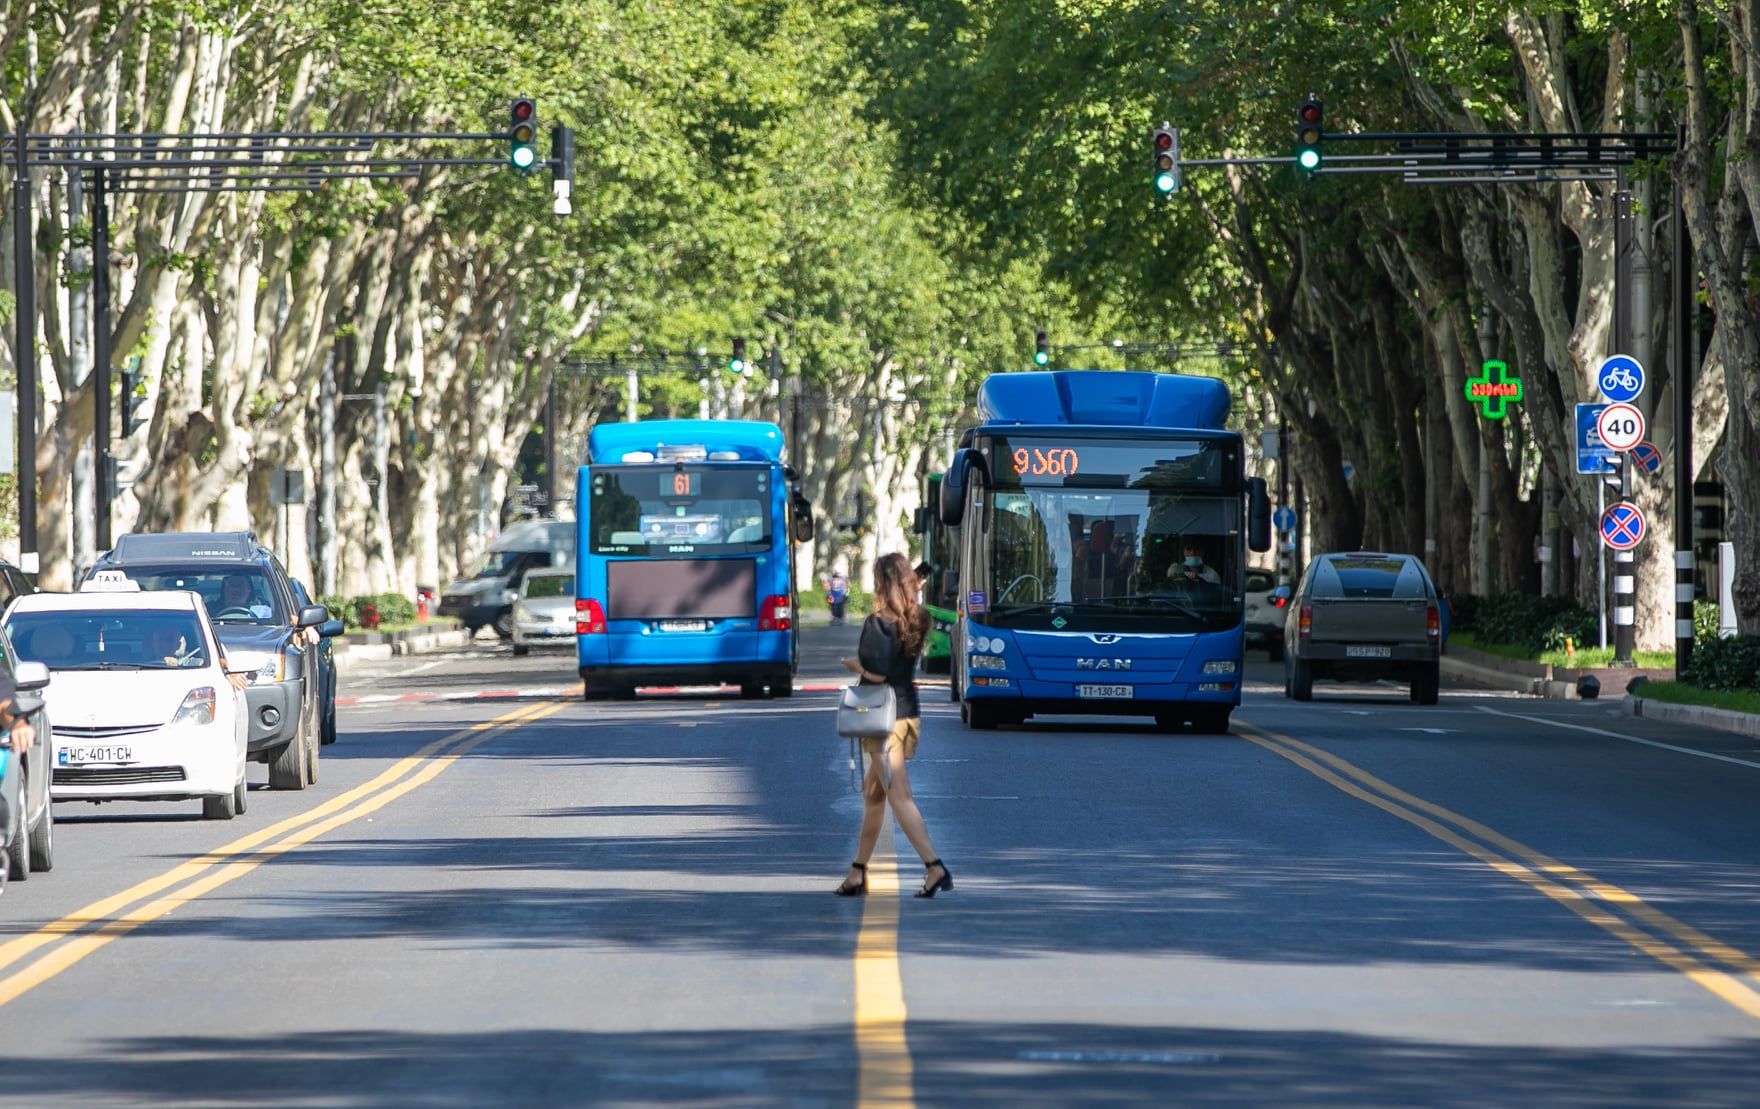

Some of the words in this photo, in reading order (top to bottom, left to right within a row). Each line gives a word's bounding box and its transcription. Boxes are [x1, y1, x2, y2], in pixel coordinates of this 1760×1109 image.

[1607, 419, 1635, 435] 40
[674, 474, 690, 495] 61
[98, 575, 123, 583] TAXI
[1076, 658, 1132, 669] MAN
